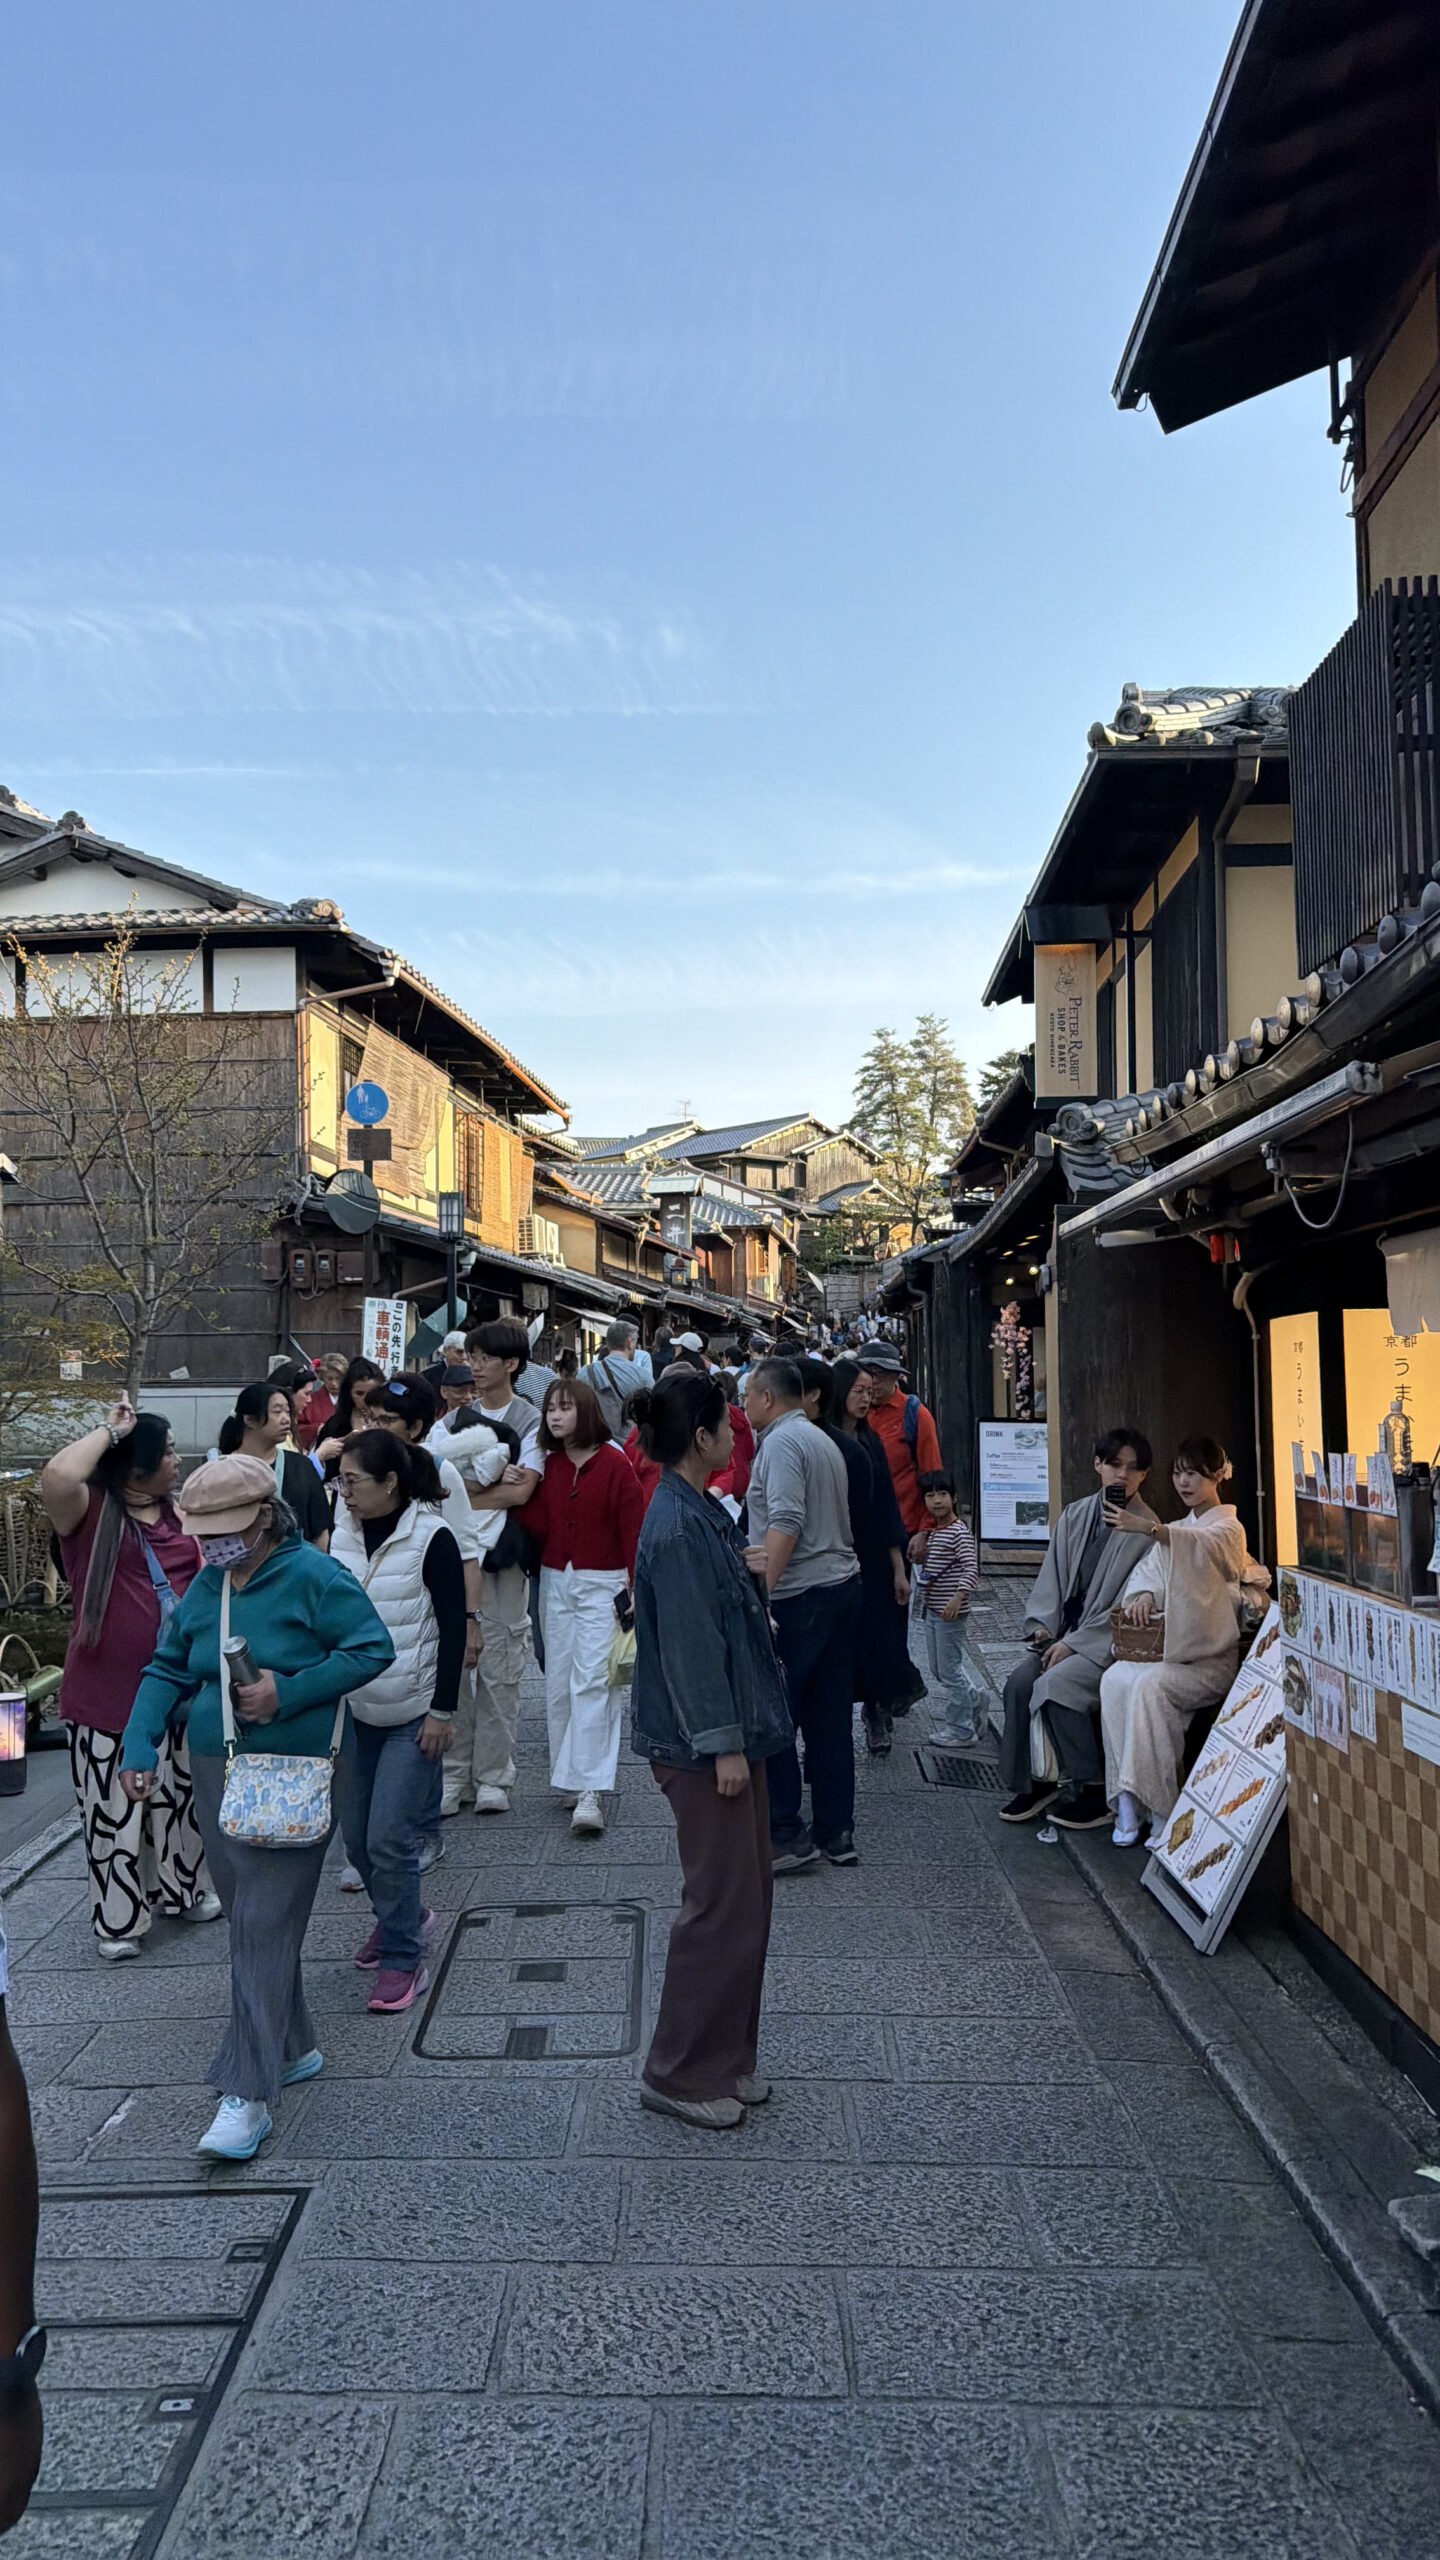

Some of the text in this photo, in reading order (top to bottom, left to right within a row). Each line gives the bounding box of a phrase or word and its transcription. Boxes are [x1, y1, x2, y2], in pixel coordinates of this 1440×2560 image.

[1057, 1007, 1066, 1032] SHOP
[1068, 997, 1083, 1083] PETER RABBIT
[1057, 1044, 1066, 1074] BAKES
[1382, 1335, 1418, 1348] 京都
[985, 1430, 1004, 1438] DRINK
